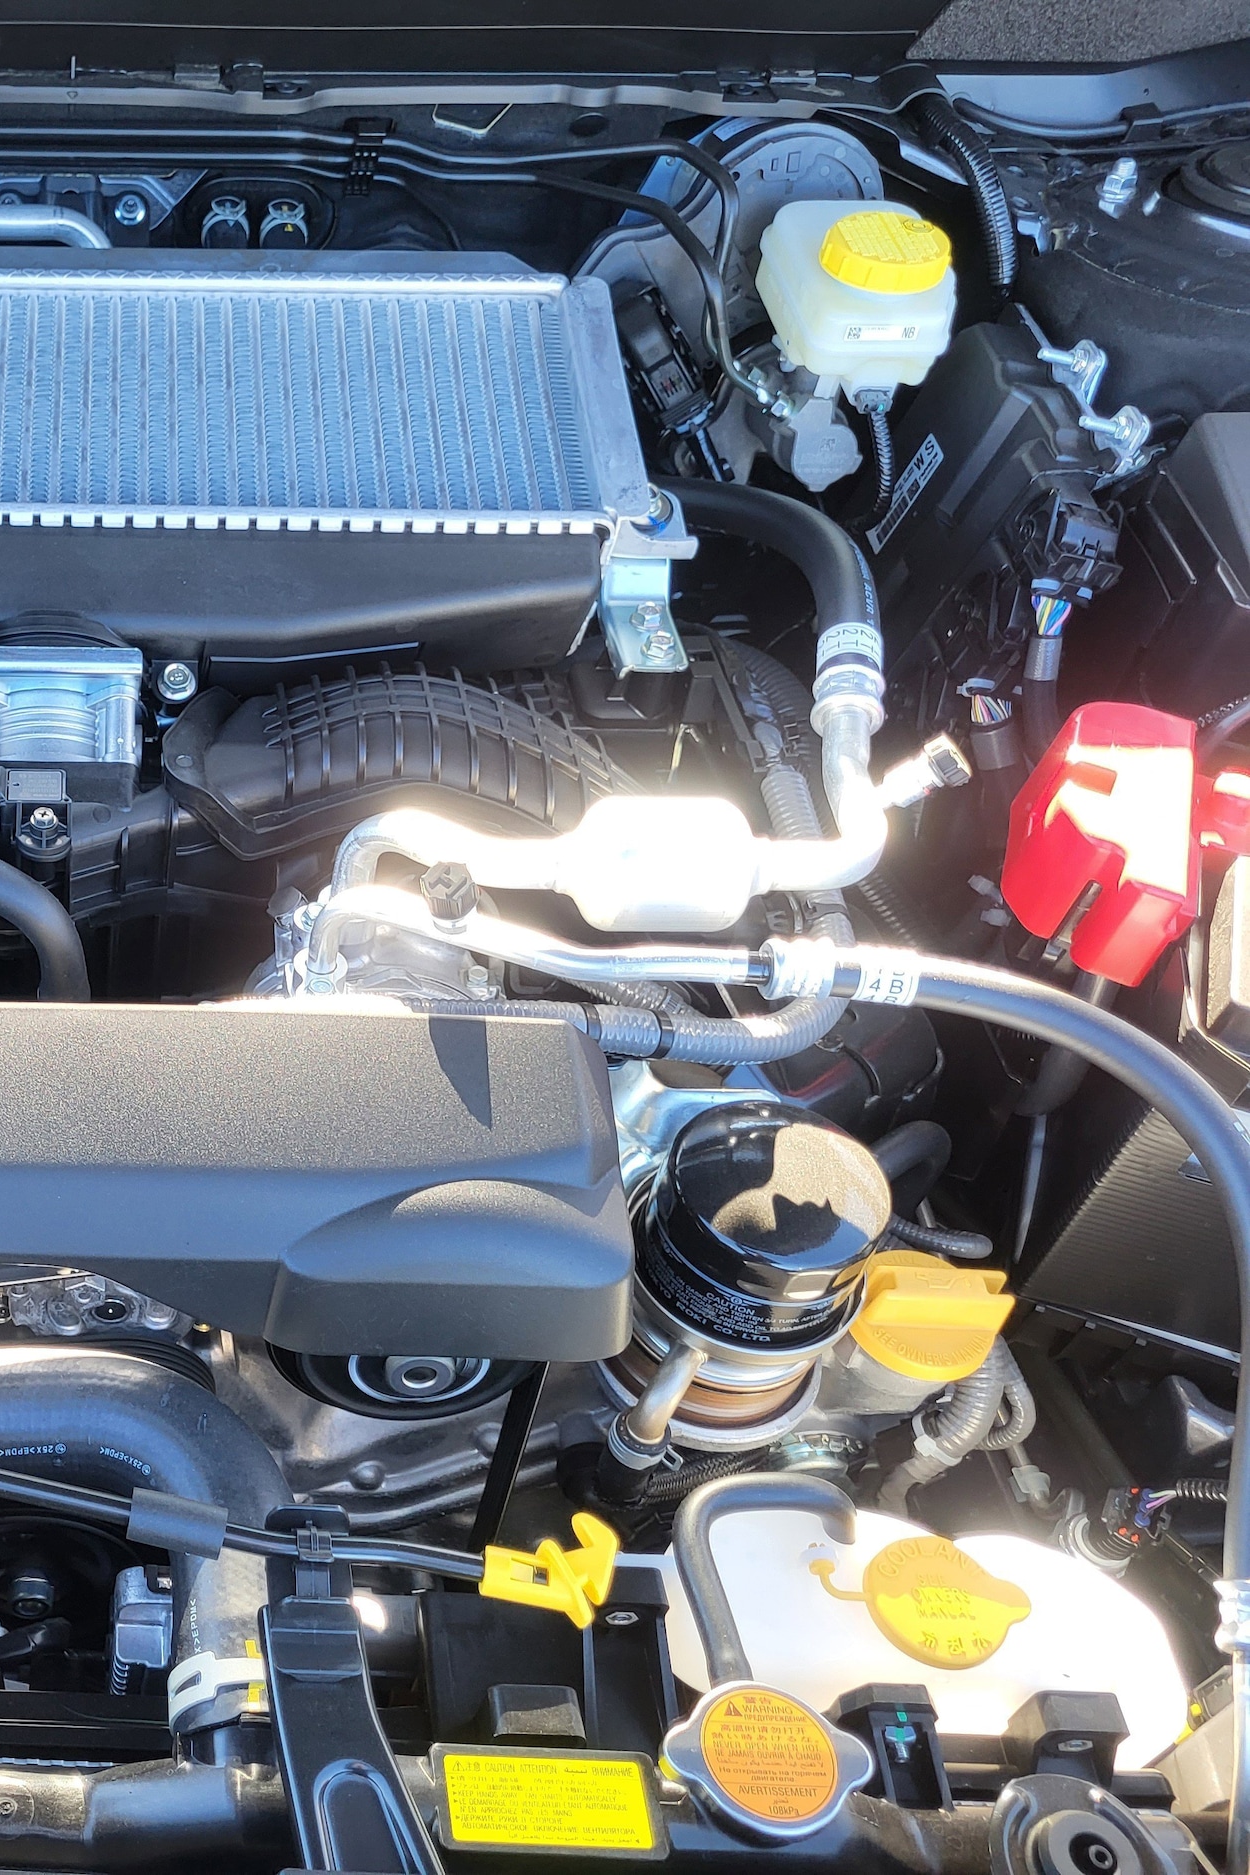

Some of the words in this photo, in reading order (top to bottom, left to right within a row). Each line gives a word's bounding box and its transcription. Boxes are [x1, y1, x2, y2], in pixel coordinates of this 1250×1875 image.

[706, 1292, 755, 1316] CAUTION
[675, 1301, 707, 1325] ROKI
[873, 1328, 896, 1348] SEE
[898, 1343, 952, 1366] OWNER'S
[952, 1334, 990, 1365] MANUAL
[878, 1540, 986, 1578] COOLANT
[742, 1704, 793, 1714] WARNING
[744, 1715, 807, 1723] ПРЕДУПРЕЖДЕНИЕ
[713, 1740, 742, 1750] NEVER
[744, 1742, 768, 1750] OPEN
[772, 1743, 798, 1752] WHEN
[715, 1749, 724, 1757] NE
[728, 1750, 754, 1758] JAMAIS
[757, 1751, 786, 1760] OUVRIR
[796, 1752, 822, 1761] CHAUD
[485, 1763, 515, 1773] CAUTION
[520, 1764, 557, 1774] ATTENTION
[738, 1785, 818, 1798] AVERTISSEMENT
[768, 1806, 800, 1816] 108kPa
